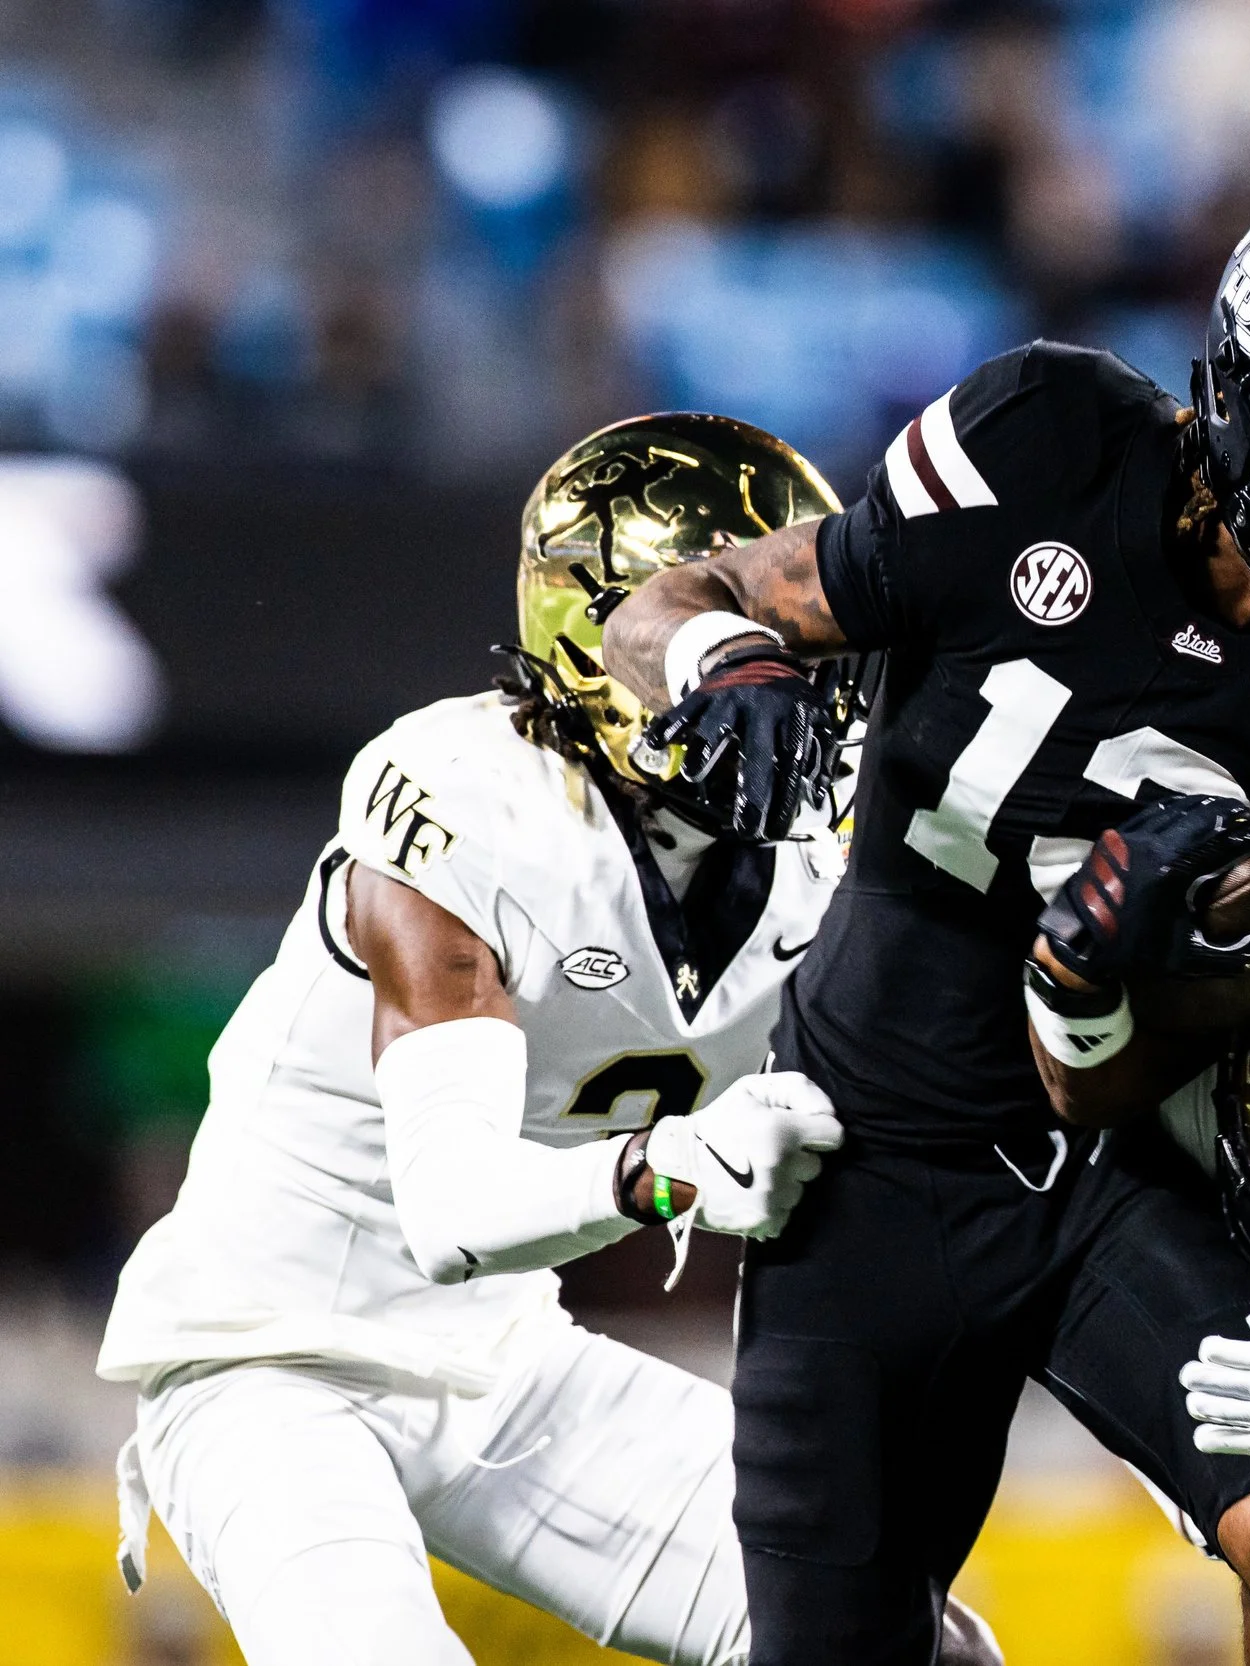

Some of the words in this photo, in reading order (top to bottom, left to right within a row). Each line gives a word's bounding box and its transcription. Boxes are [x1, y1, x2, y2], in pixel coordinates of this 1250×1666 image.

[1016, 547, 1085, 619] SEC
[1171, 624, 1222, 664] State
[365, 759, 456, 879] WF
[568, 956, 623, 977] ACC
